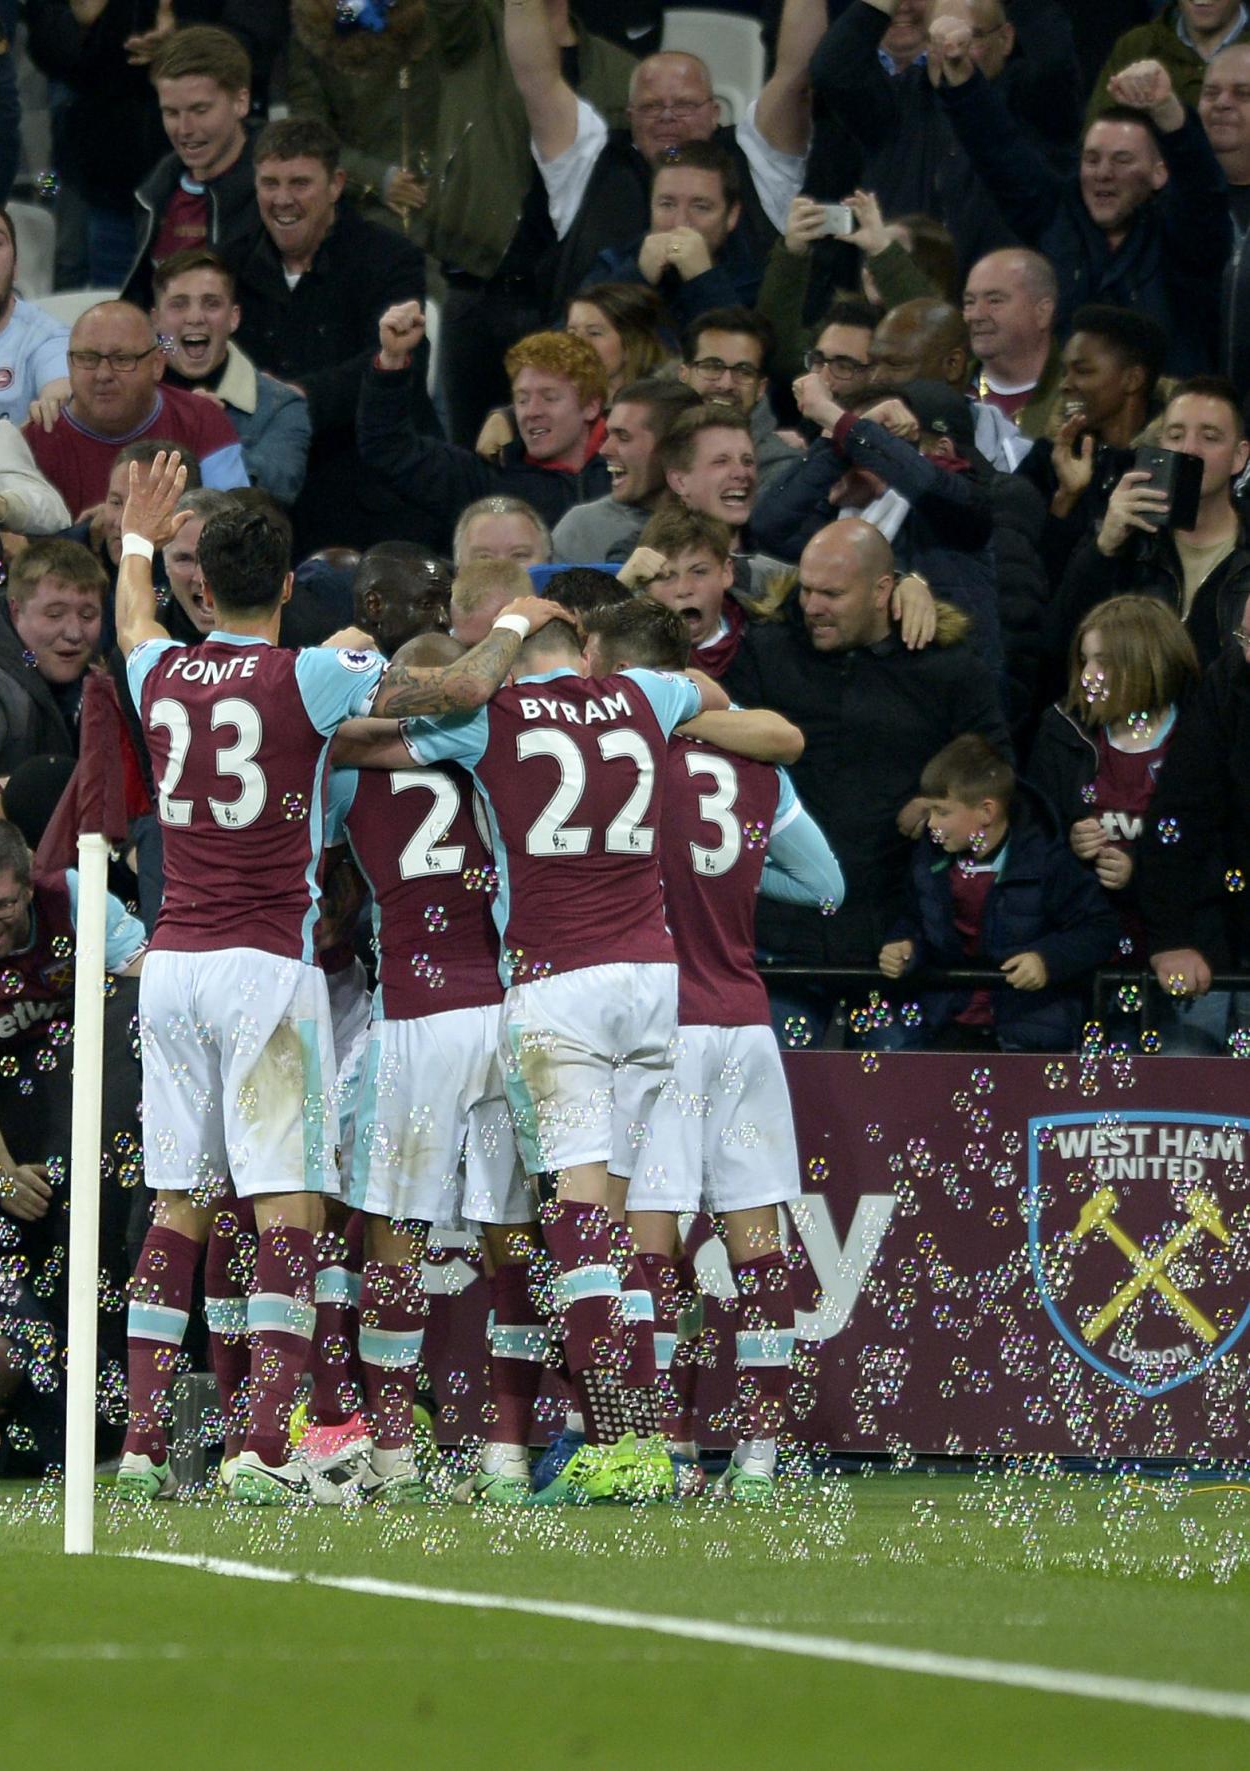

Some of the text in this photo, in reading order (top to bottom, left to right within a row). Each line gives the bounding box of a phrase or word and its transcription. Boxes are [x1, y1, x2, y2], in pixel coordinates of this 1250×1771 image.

[166, 656, 259, 685] FONTE
[519, 691, 632, 725] BYRAM
[150, 697, 267, 829] 23
[516, 727, 655, 856] 22
[685, 751, 741, 877] 3
[1056, 1127, 1245, 1163] WEST HAM
[1097, 1157, 1205, 1182] UNITED
[1108, 1342, 1191, 1366] LONDON
